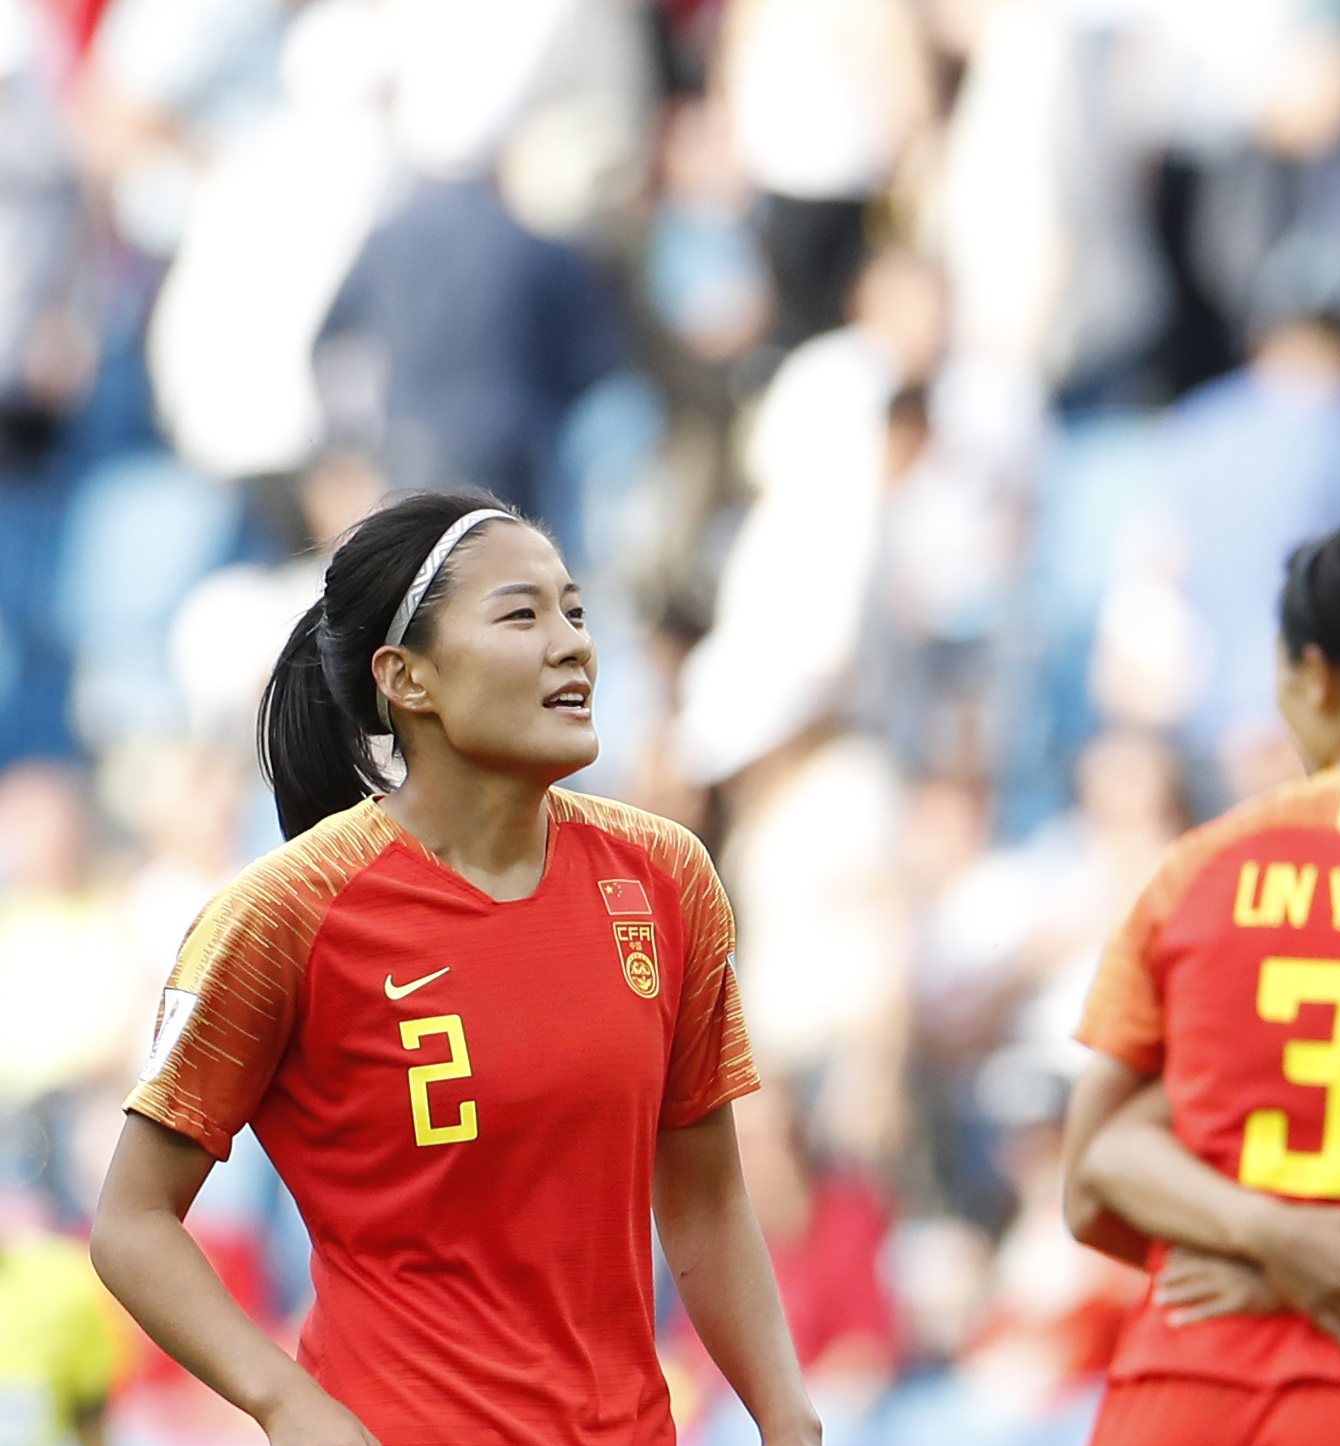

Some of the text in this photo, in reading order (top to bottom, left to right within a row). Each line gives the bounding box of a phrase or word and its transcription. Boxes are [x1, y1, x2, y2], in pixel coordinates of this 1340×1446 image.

[1233, 860, 1318, 928] LIN
[616, 926, 651, 941] CFA
[398, 1013, 479, 1147] 2
